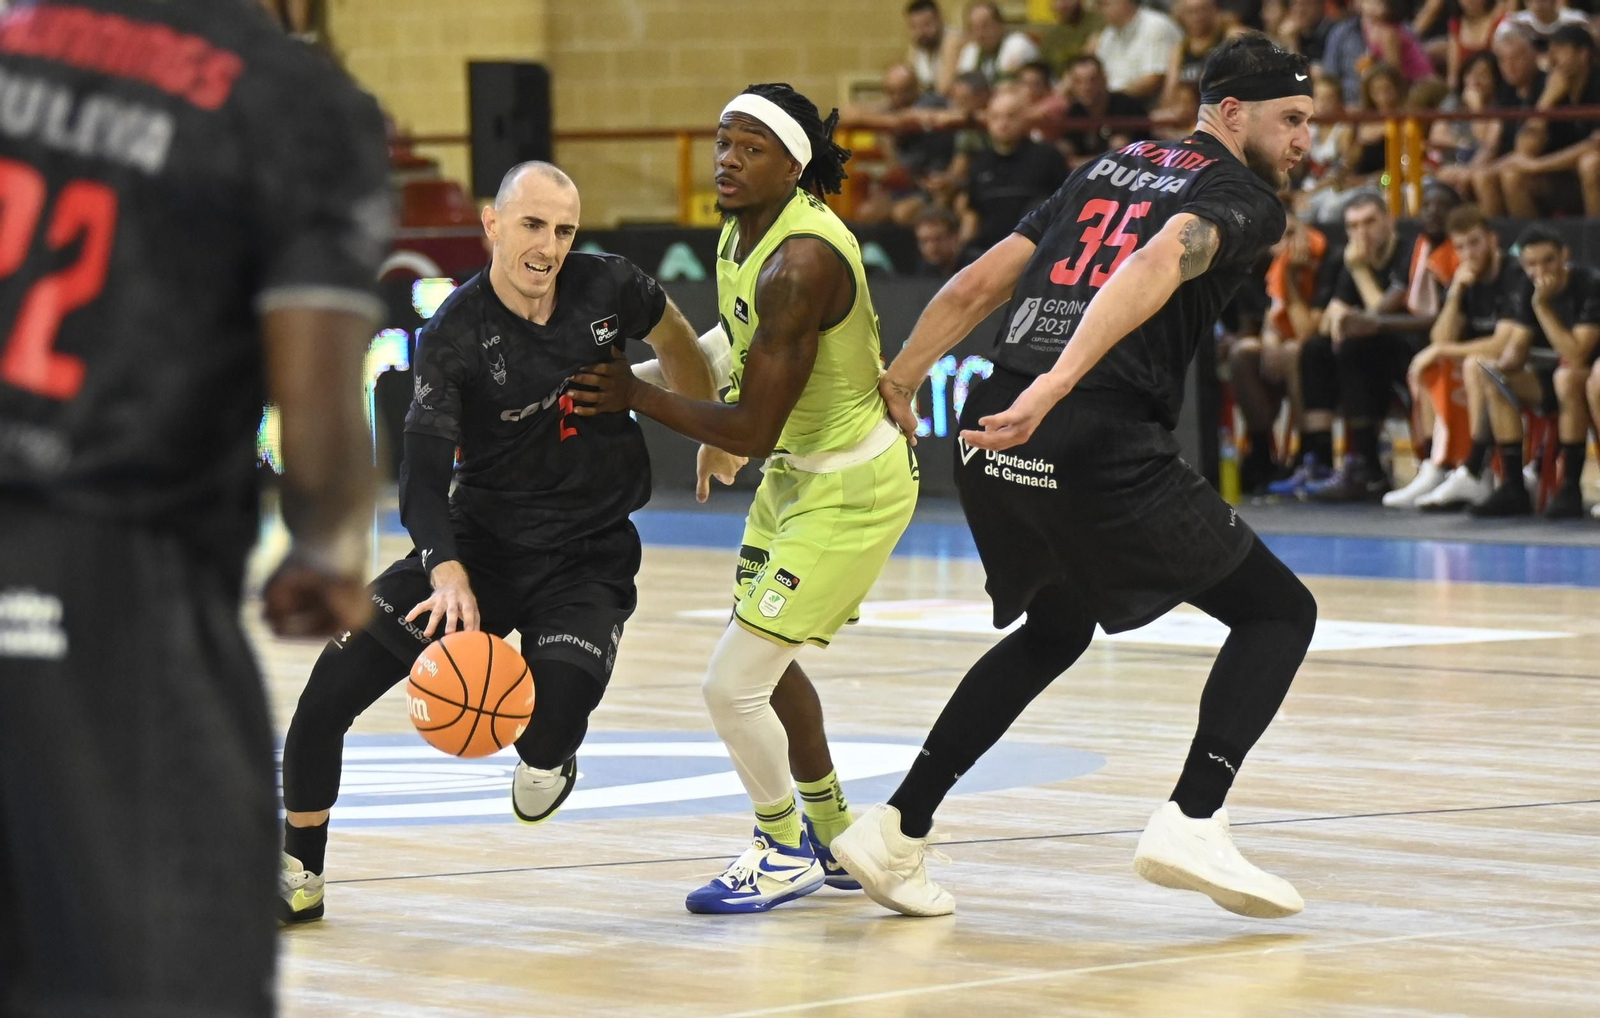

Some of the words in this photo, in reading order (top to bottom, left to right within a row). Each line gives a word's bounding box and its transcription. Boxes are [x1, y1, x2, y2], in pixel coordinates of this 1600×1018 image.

[1050, 198, 1152, 288] 35
[1043, 299, 1087, 315] GRAN
[1035, 316, 1072, 336] 2031
[559, 394, 578, 442] 2
[985, 449, 1055, 474] Diputación
[984, 463, 1000, 478] de
[1002, 467, 1058, 489] Granada
[776, 573, 793, 587] acb
[371, 594, 395, 613] vive
[546, 633, 602, 658] BERNER
